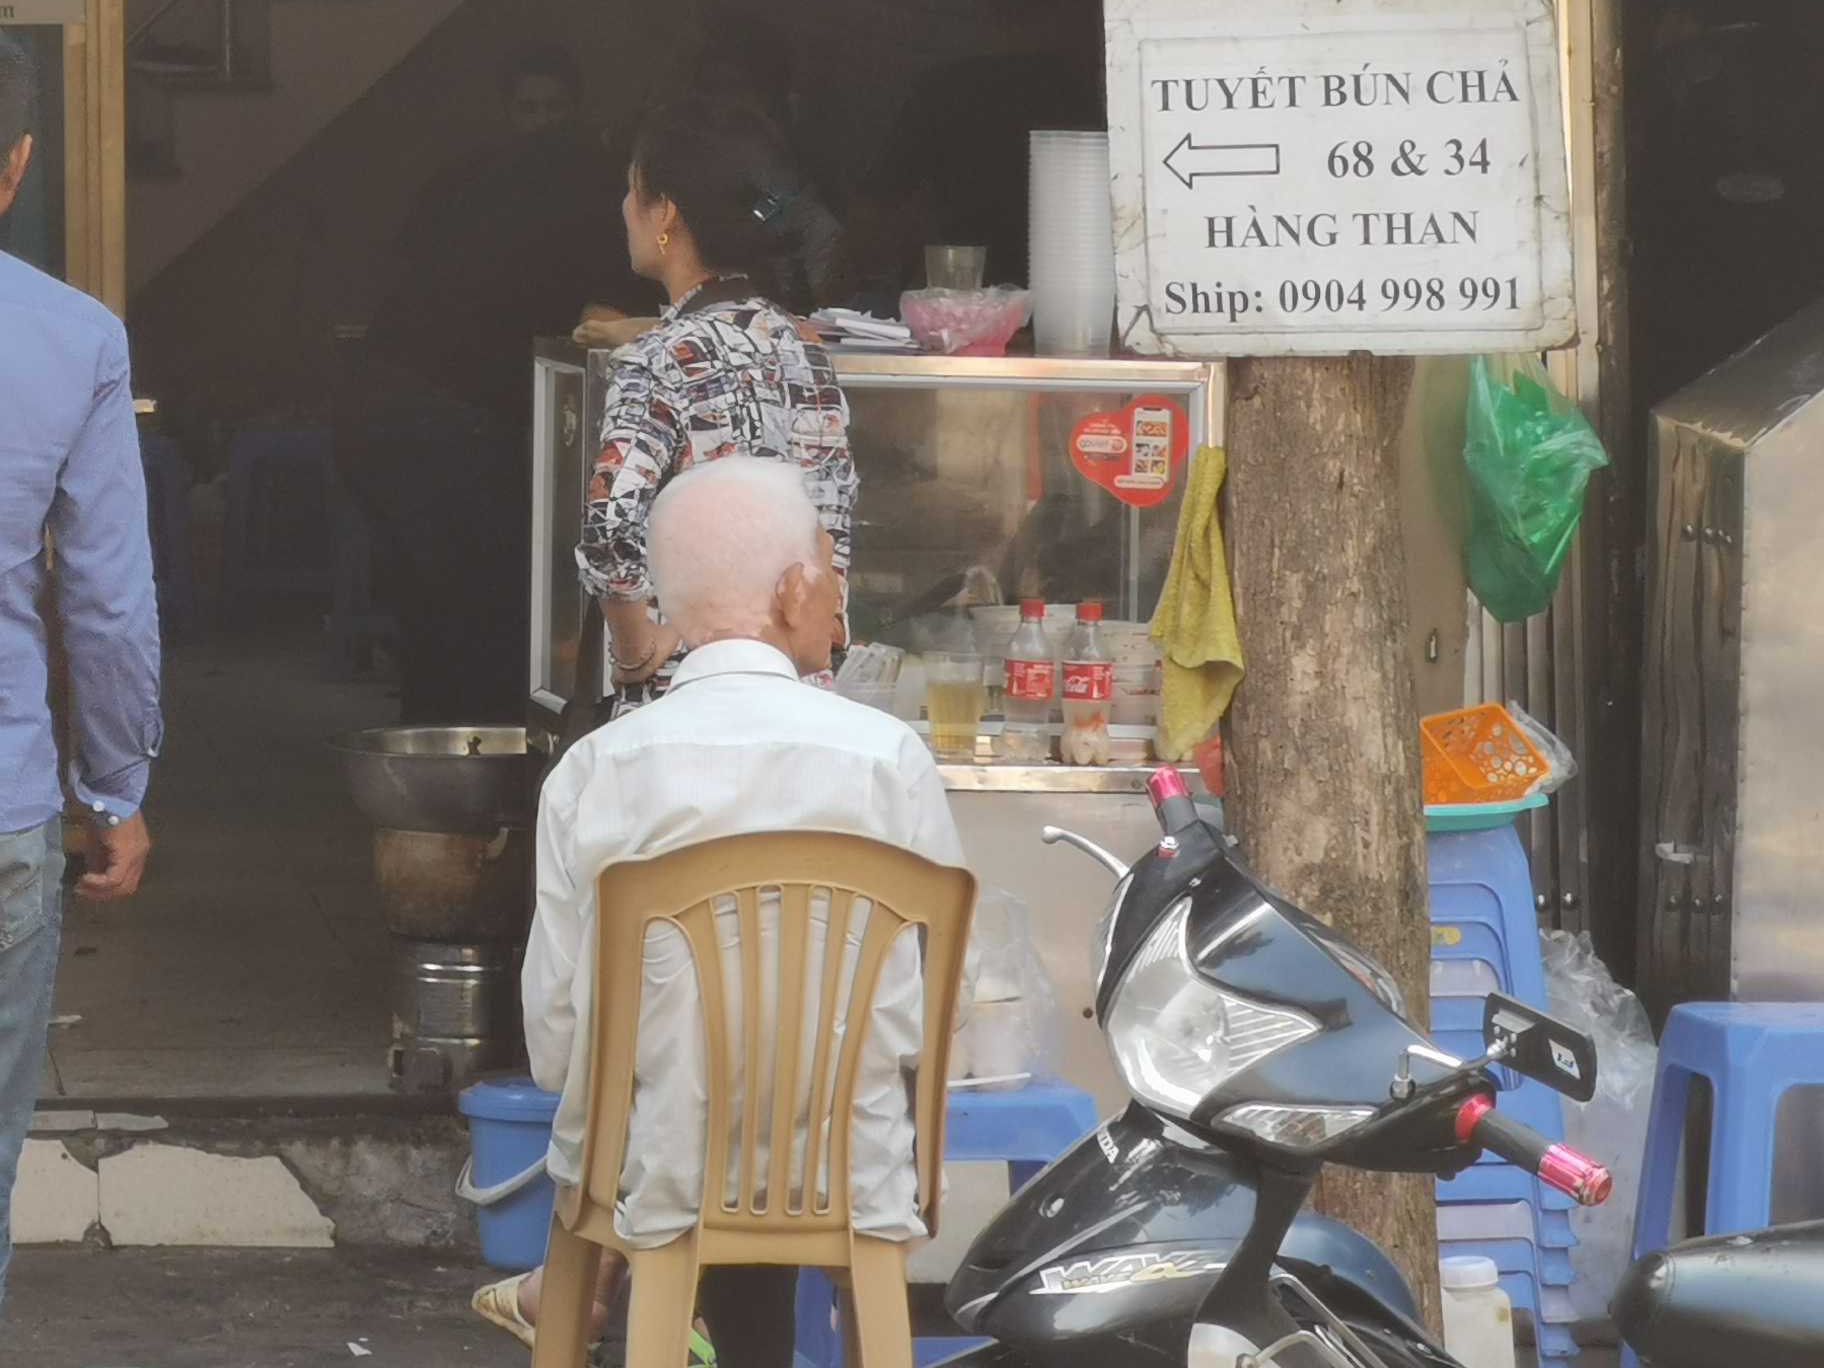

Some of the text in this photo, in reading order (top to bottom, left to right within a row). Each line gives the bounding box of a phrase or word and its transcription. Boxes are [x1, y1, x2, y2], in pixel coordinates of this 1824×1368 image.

[1151, 59, 1520, 111] TUYẾT BÚN CHẢ
[1327, 138, 1491, 178] 68 & 34
[1204, 205, 1479, 248] HÀNG THAN
[1165, 277, 1519, 322] Ship: 0904 998 991
